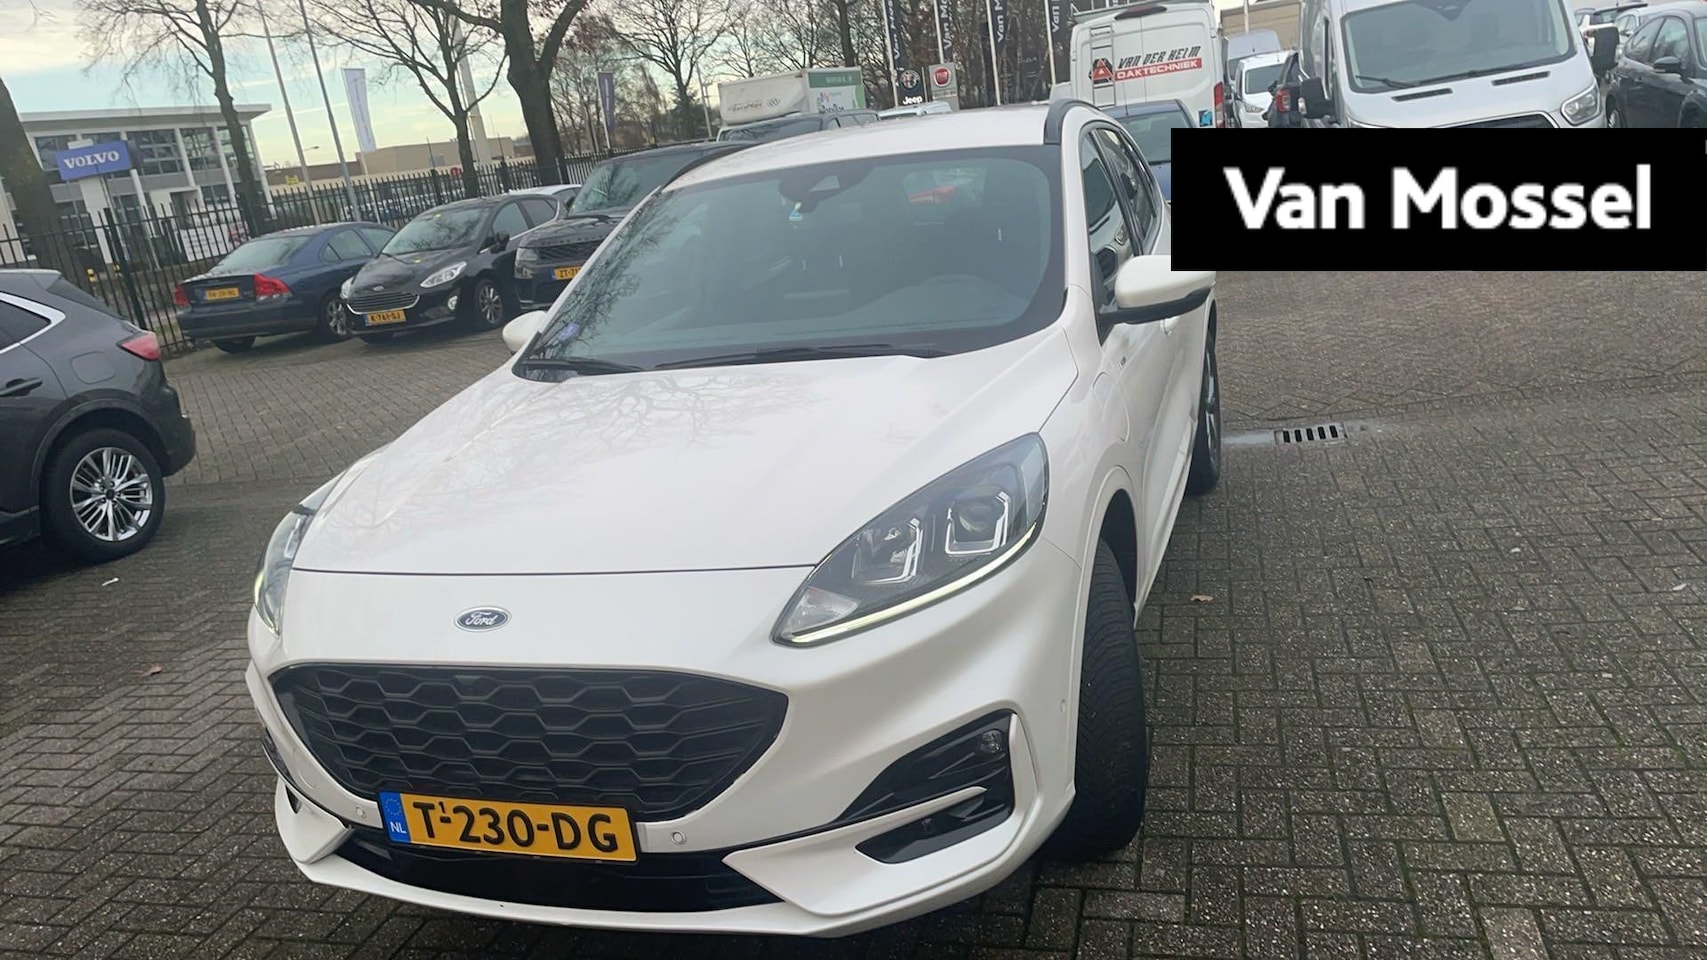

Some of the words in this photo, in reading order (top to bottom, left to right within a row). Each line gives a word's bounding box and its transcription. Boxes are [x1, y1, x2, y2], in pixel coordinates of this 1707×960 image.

[996, 15, 1005, 43] Van
[1052, 6, 1060, 33] Van
[943, 23, 952, 50] Van
[1118, 55, 1141, 69] VAN
[1143, 51, 1166, 65] DER
[1116, 60, 1199, 80] DAKTECHNIEK
[902, 96, 923, 105] Jeep
[64, 150, 120, 169] VOLVO
[465, 611, 498, 626] Ford
[389, 821, 407, 834] NL
